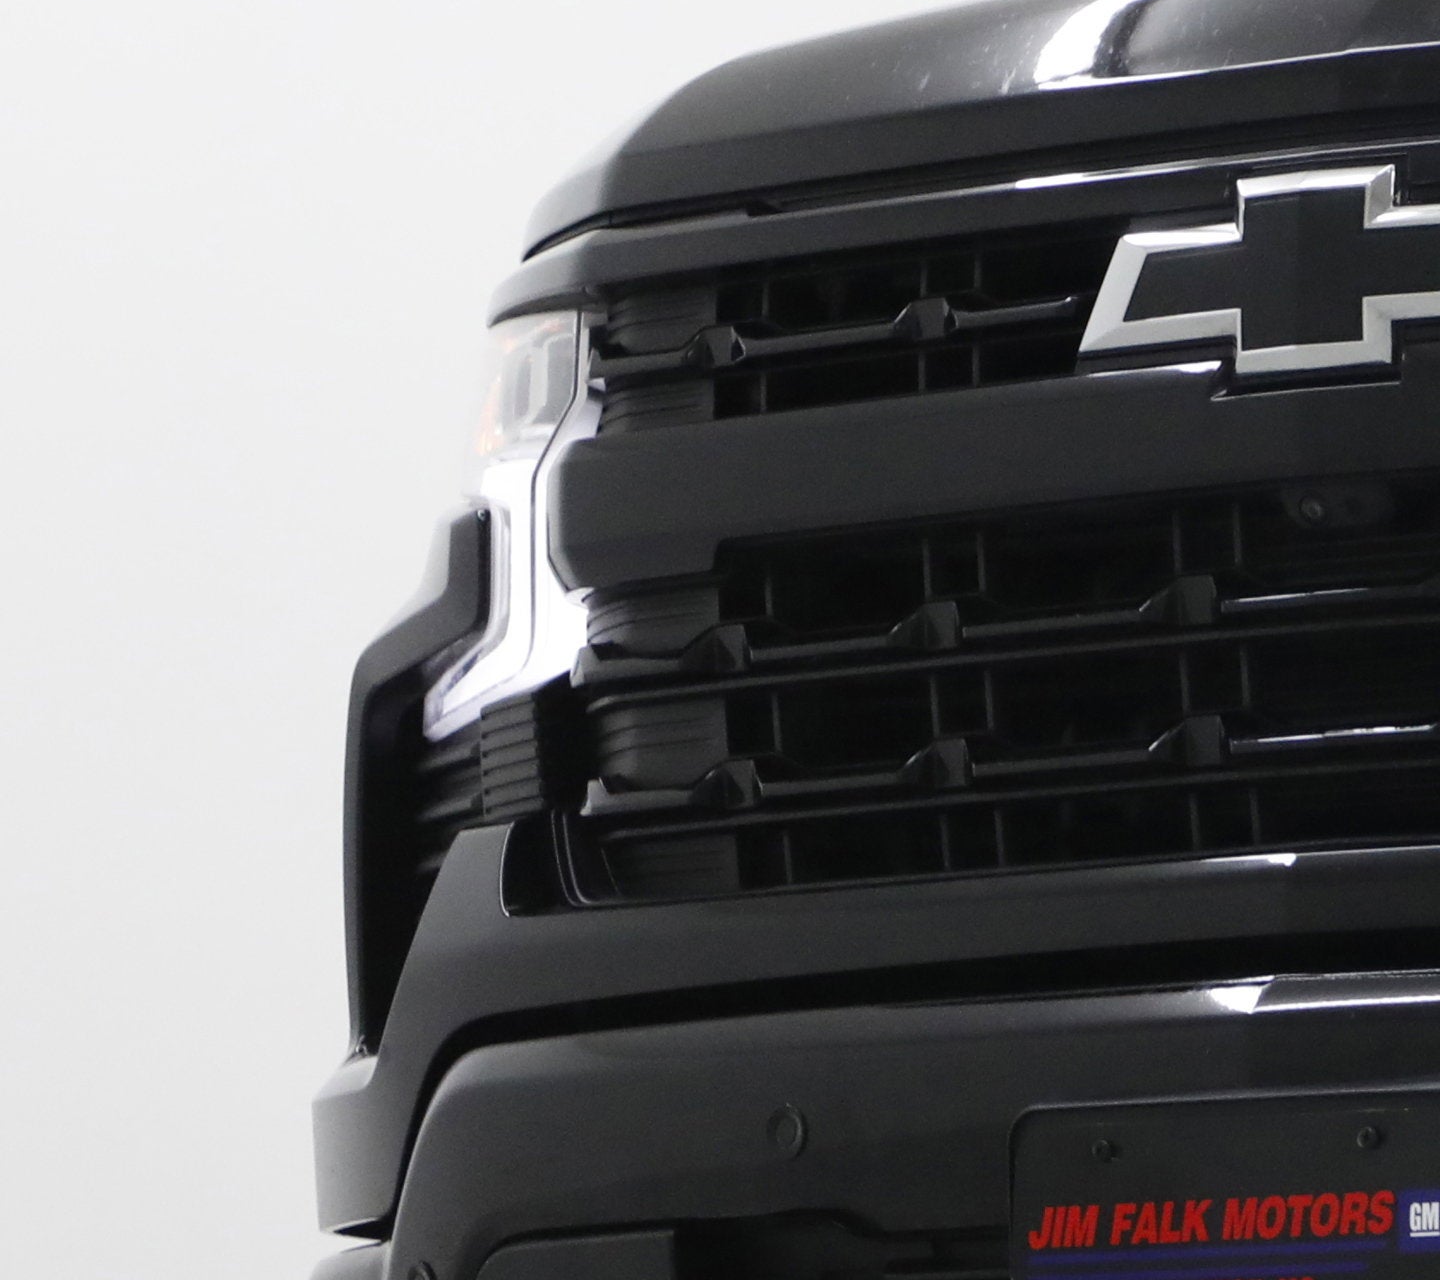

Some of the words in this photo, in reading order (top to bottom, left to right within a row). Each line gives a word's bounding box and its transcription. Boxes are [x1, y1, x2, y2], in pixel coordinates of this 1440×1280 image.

[1028, 1205, 1099, 1250] JIM
[1110, 1199, 1213, 1245] FALK
[1222, 1190, 1396, 1240] MOTORS
[1409, 1201, 1440, 1236] GM
